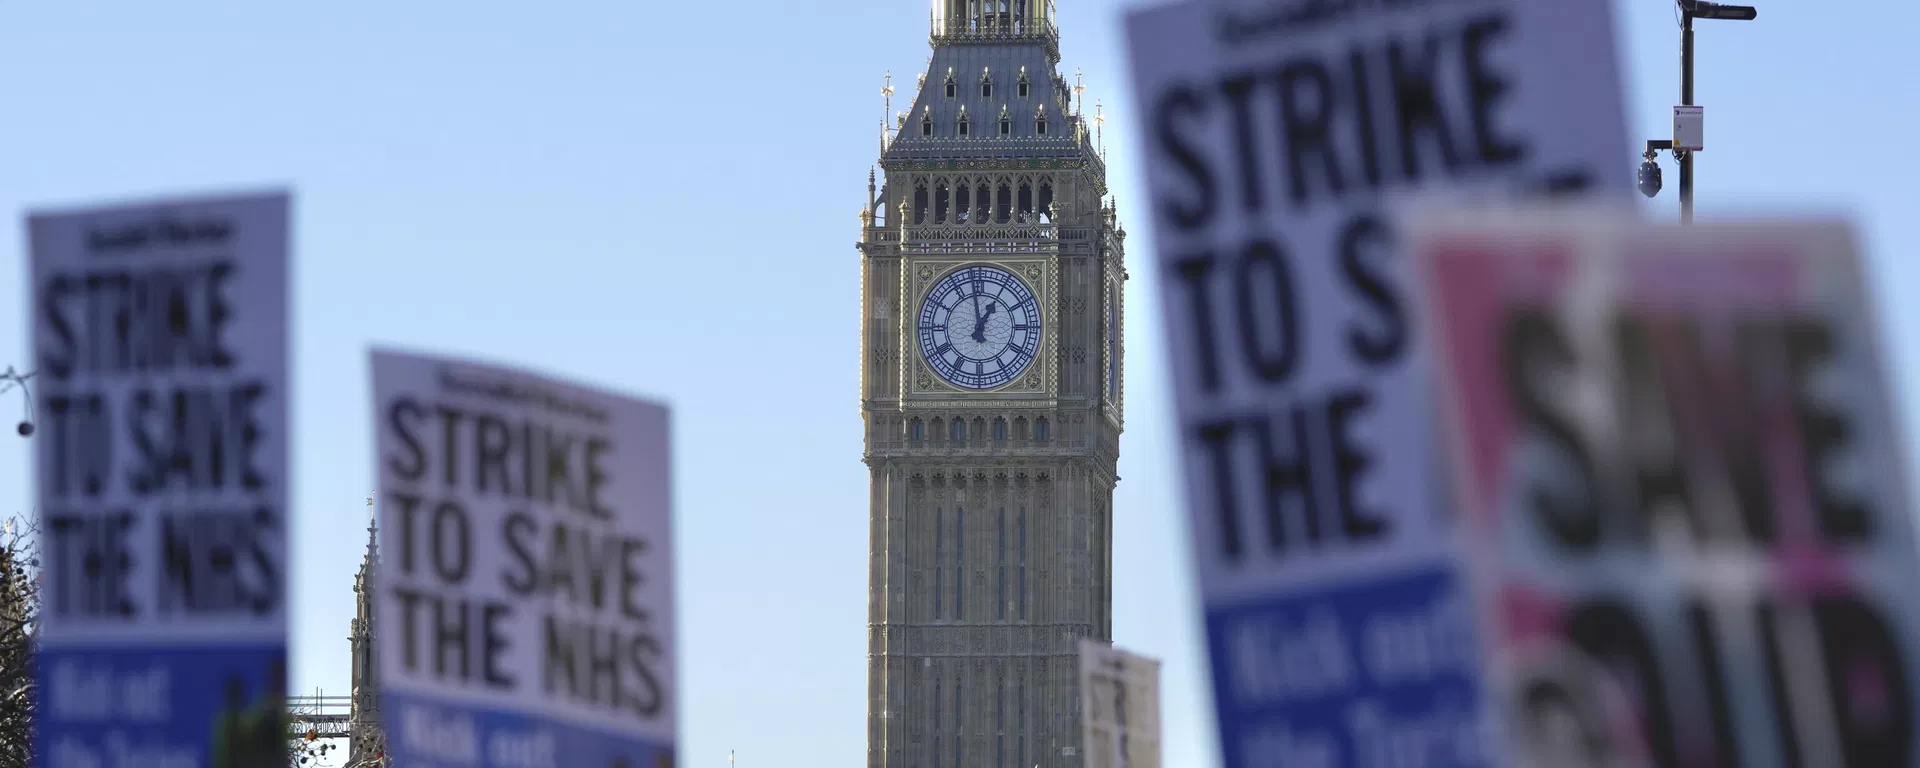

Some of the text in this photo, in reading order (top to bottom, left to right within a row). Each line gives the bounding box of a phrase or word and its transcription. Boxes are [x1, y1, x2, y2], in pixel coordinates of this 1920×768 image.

[1155, 15, 1526, 229] STRIKE
[41, 261, 237, 379] STRIKE
[1172, 238, 1294, 393] TO
[42, 380, 267, 496] TO SAVE
[388, 398, 614, 520] STRIKE
[1184, 390, 1396, 566] THE
[1495, 304, 1872, 564] SAVE
[45, 507, 279, 622] THE NHS
[388, 493, 649, 621] TO SAVE
[391, 586, 664, 720] THE NHS
